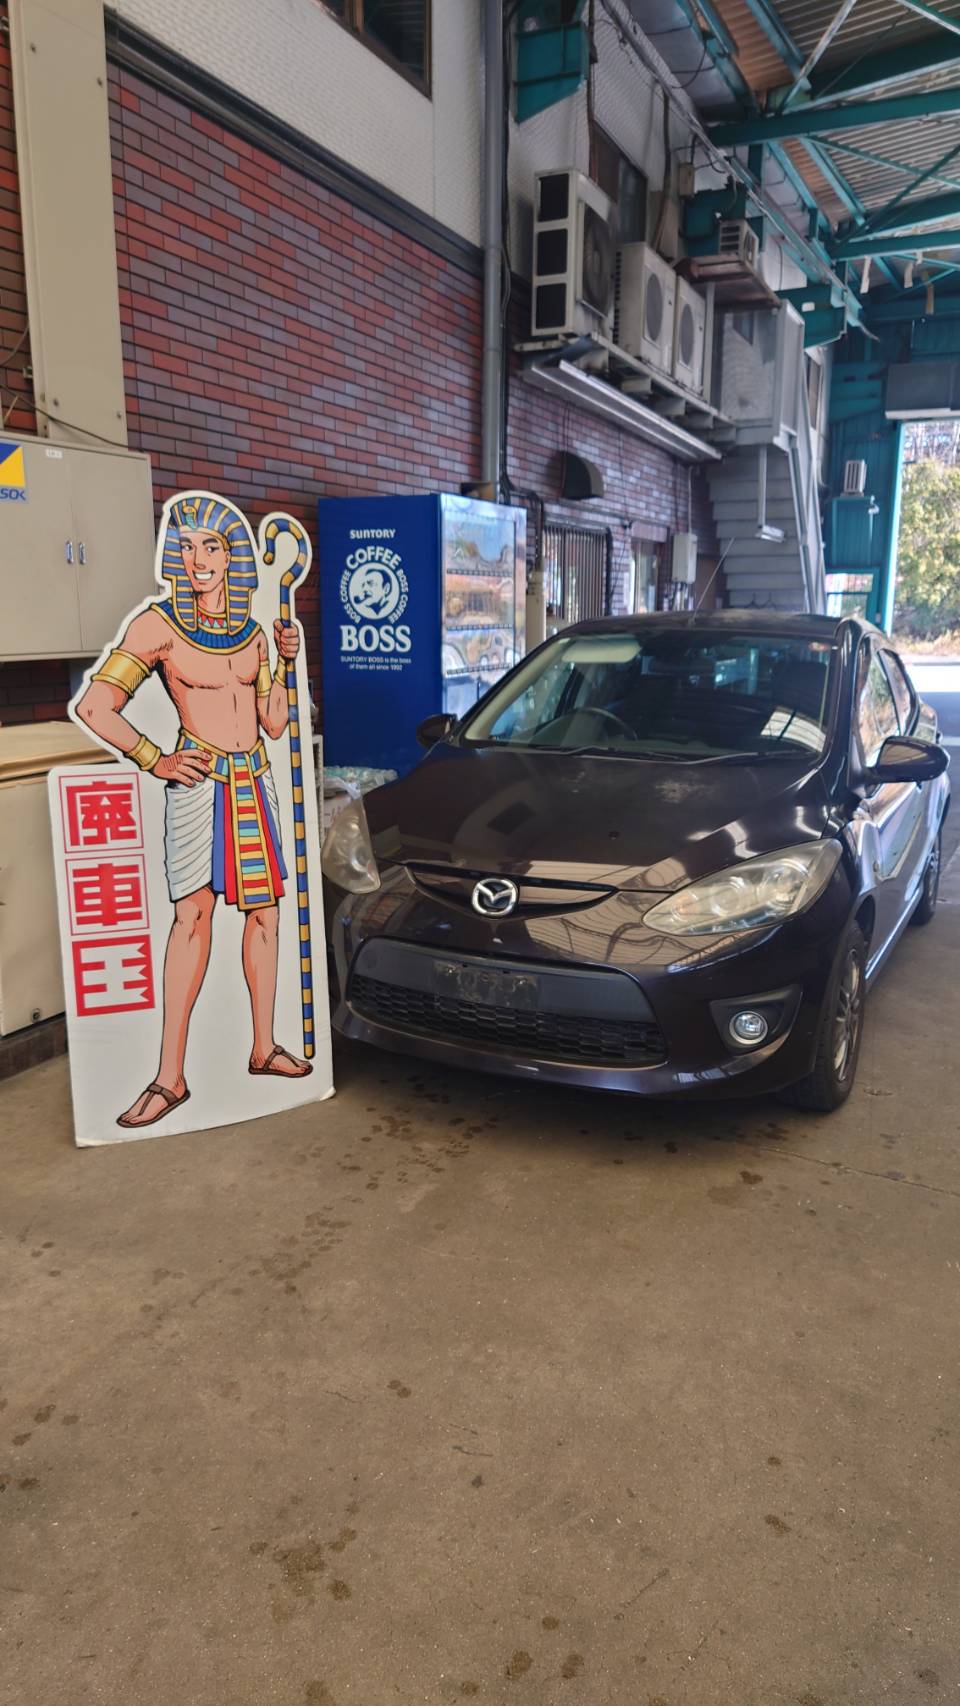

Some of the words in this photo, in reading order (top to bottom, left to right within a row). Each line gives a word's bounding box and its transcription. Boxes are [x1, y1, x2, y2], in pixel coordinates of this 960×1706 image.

[350, 528, 396, 539] SUNTORY
[346, 546, 401, 570] COFFEE
[340, 569, 351, 603] COFFEE
[396, 568, 409, 593] BOSS
[343, 603, 361, 624] BOSS
[388, 594, 409, 624] COFFEE
[340, 625, 412, 653] BOSS
[59, 772, 155, 1016] 廃車王
